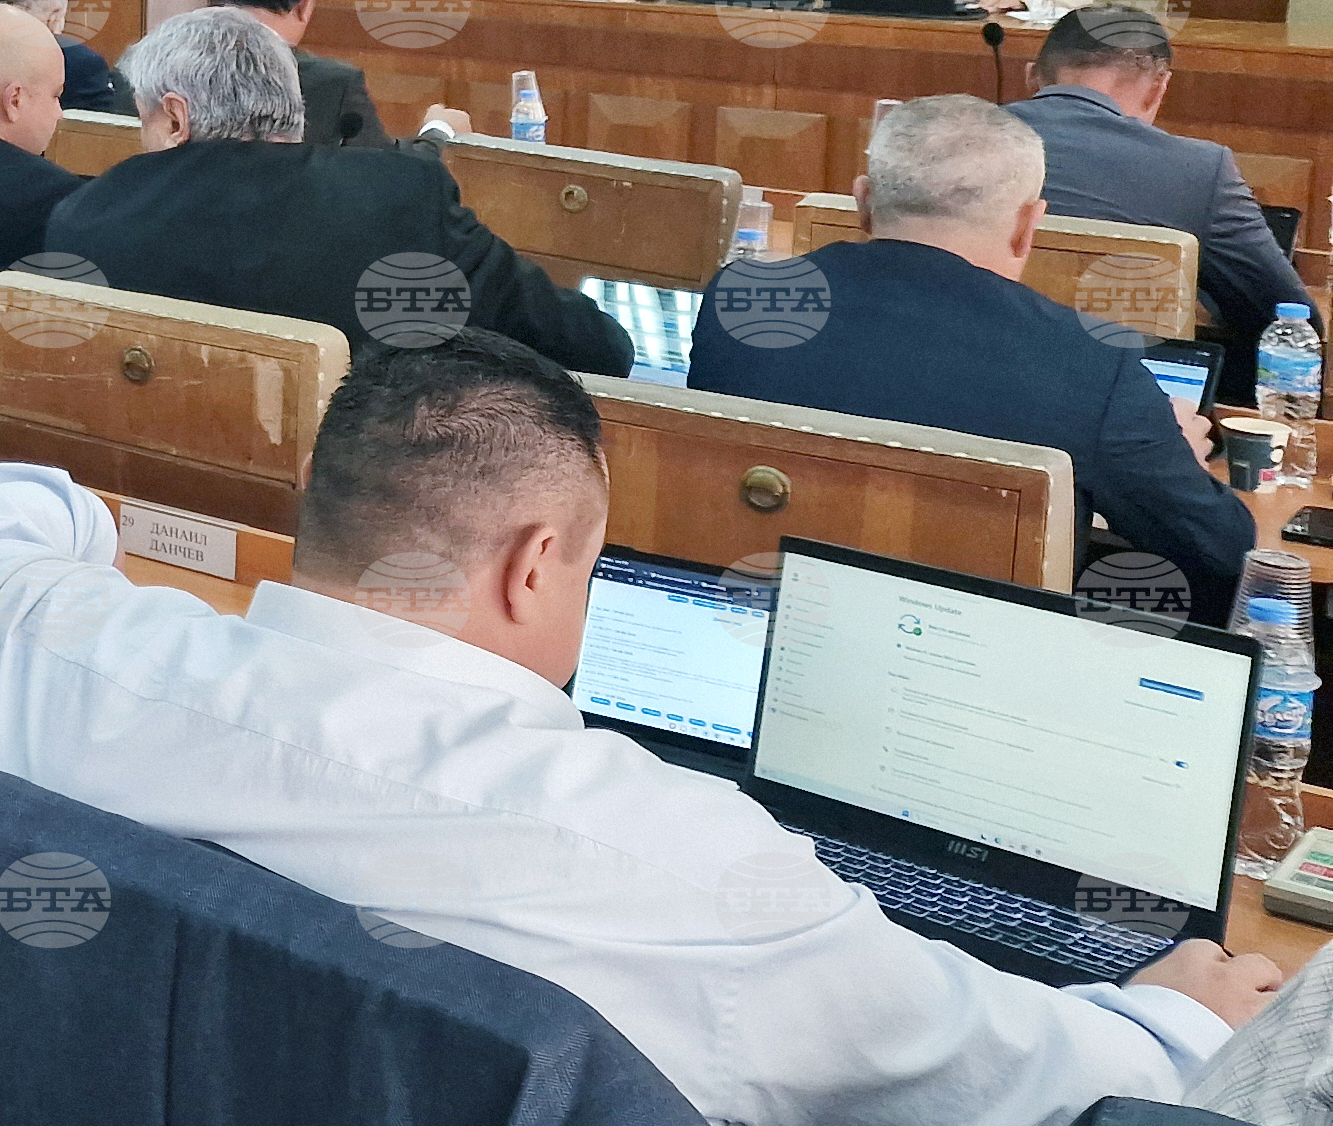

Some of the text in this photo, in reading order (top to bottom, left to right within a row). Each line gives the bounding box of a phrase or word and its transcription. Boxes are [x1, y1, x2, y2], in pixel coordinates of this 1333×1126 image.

[122, 515, 135, 527] 29
[150, 522, 208, 546] ДАНАИЛ
[149, 538, 205, 562] ДАНЧЕВ
